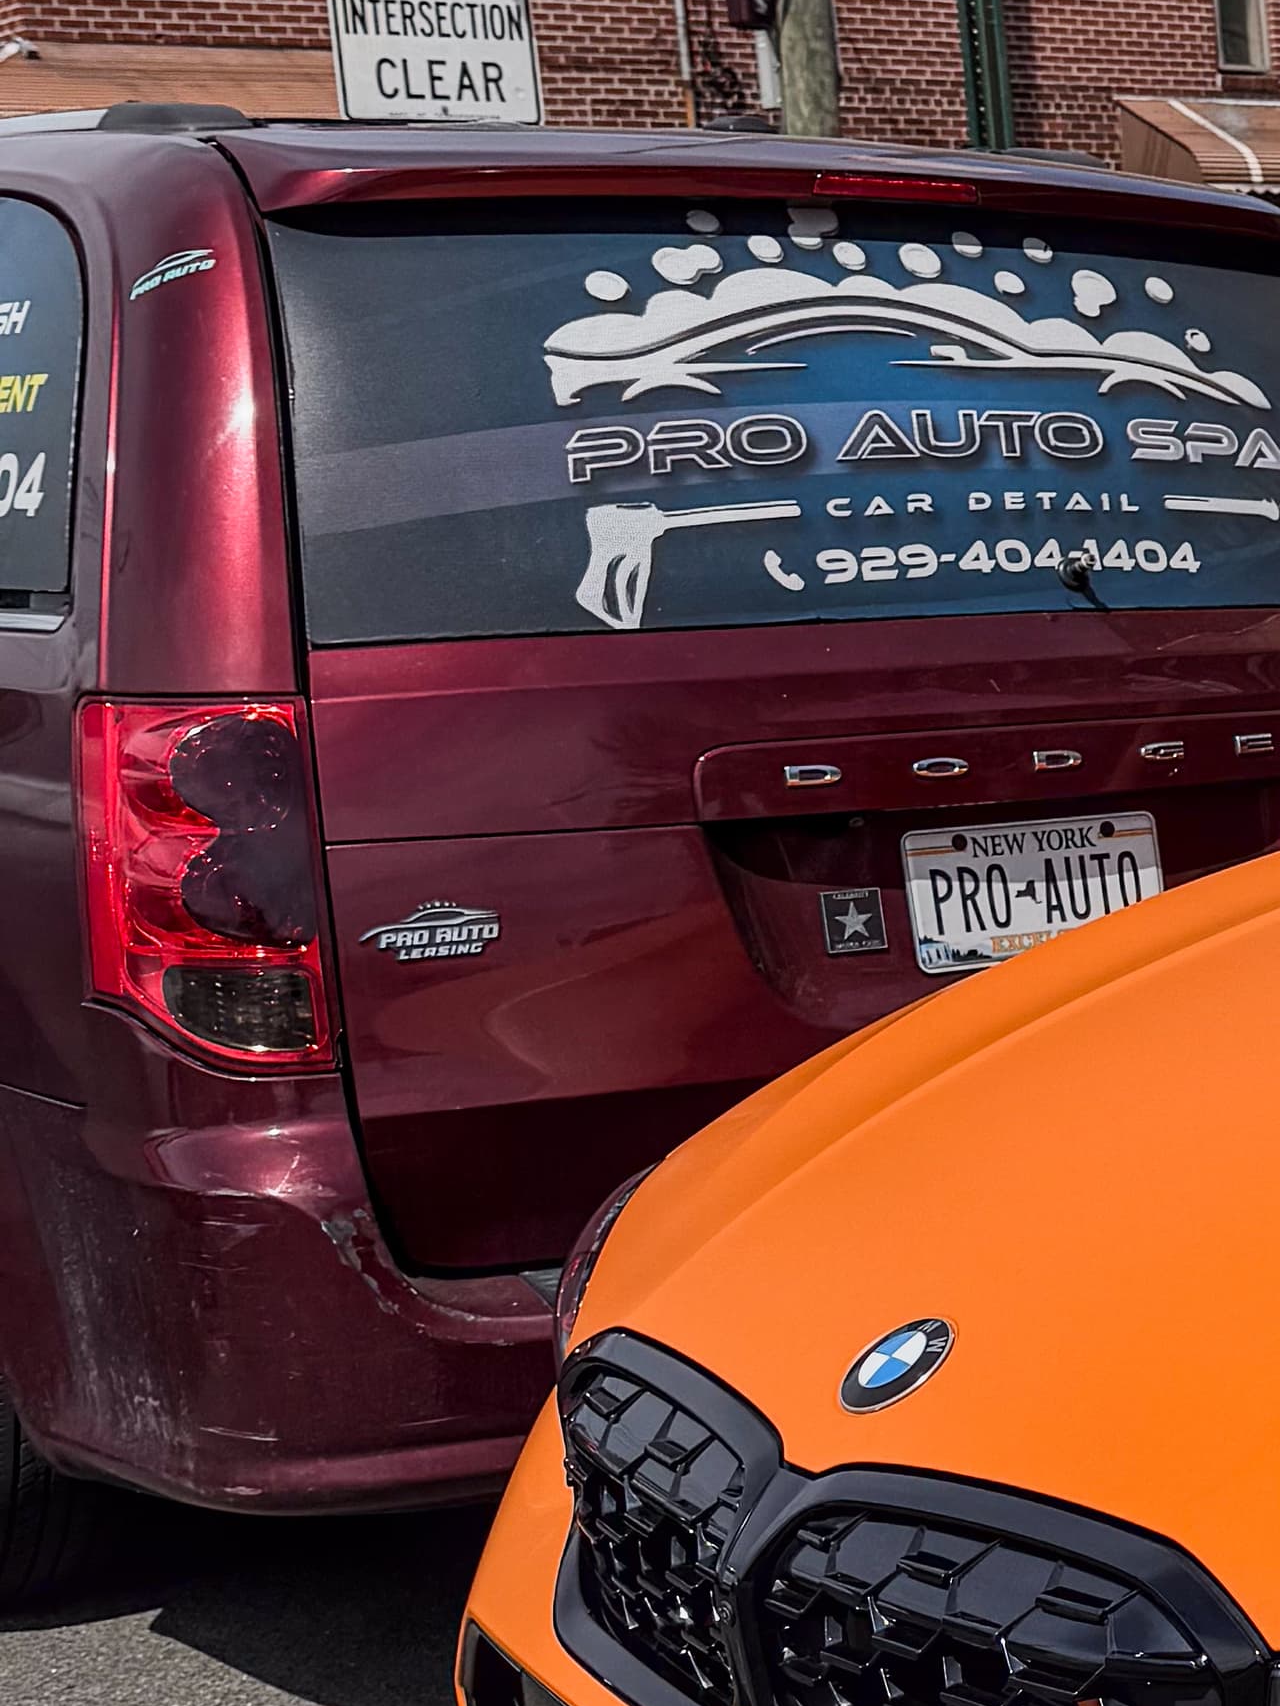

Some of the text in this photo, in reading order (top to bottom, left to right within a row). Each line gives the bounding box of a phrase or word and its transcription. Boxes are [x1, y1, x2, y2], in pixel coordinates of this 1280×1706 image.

[376, 57, 506, 103] CLEAR
[566, 412, 808, 484] PRO
[835, 409, 1105, 463] AUTO
[825, 491, 1141, 518] CAR DETAIL
[815, 537, 1202, 586] 929-404-1404
[783, 732, 1276, 787] DODGE
[969, 825, 1098, 859] NEW YORK
[378, 922, 500, 949] PRO AUTO
[396, 941, 484, 961] LEASING
